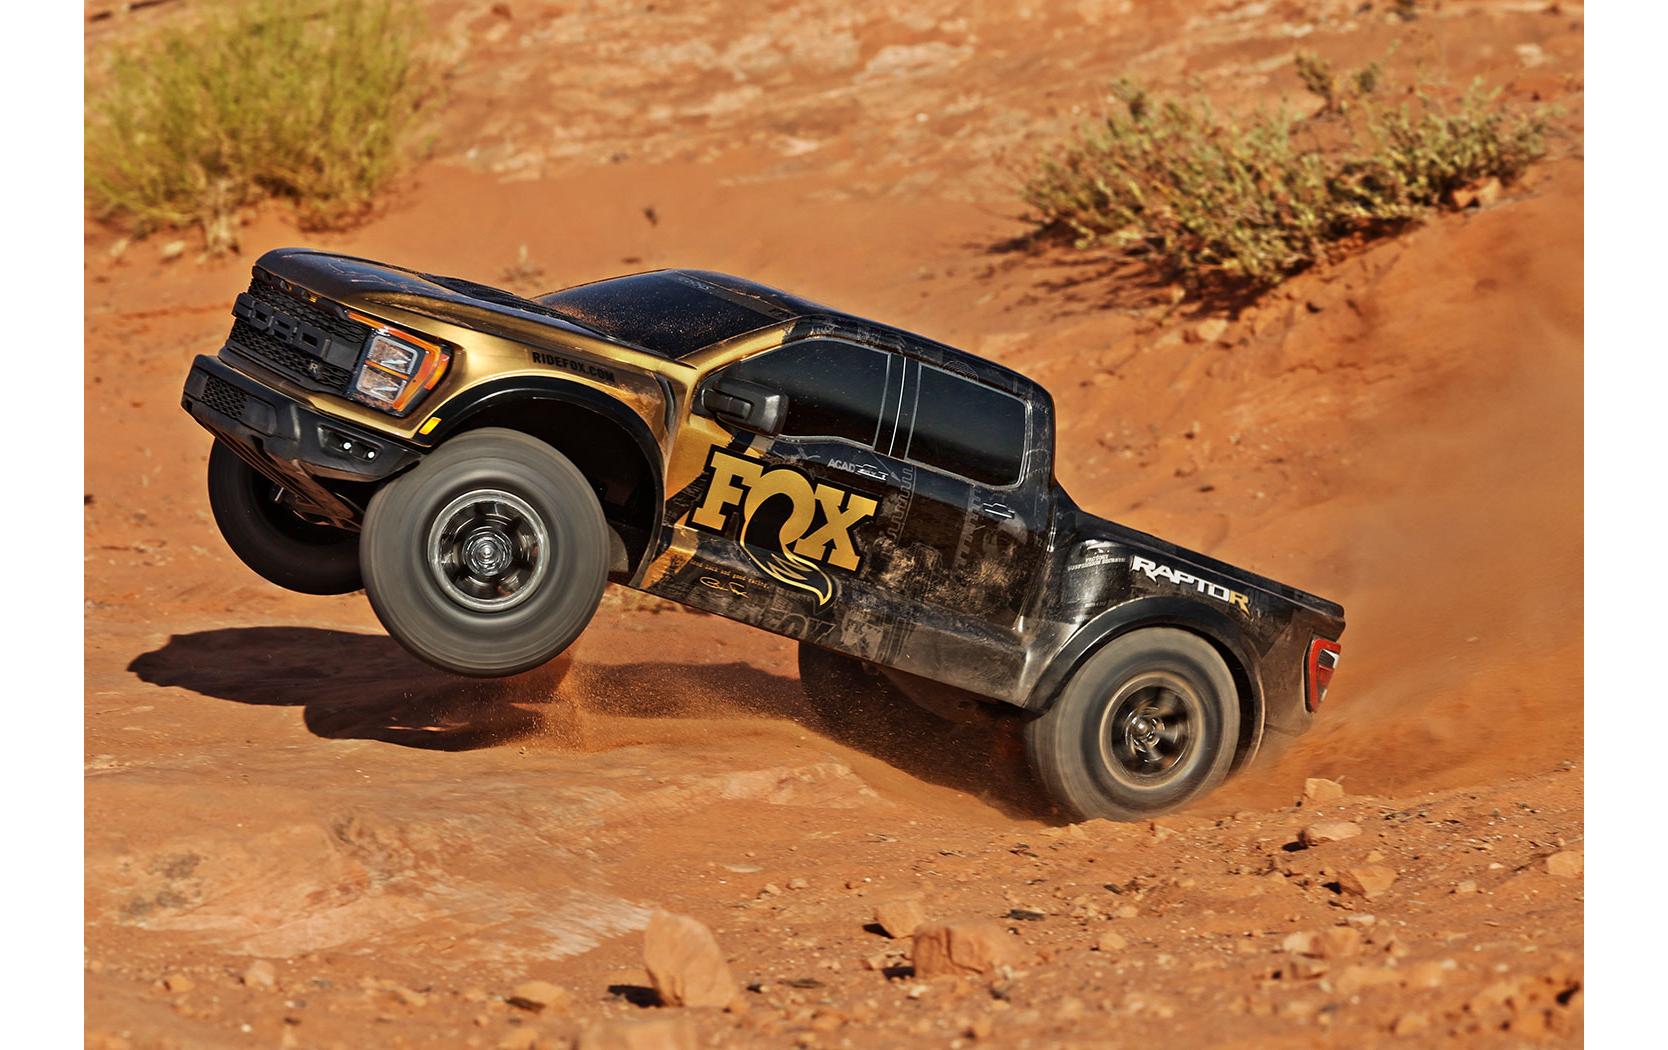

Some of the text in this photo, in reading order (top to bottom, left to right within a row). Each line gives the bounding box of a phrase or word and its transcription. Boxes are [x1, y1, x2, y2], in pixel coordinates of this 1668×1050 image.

[532, 351, 616, 383] RIDEFOX.COM
[826, 458, 860, 476] ACAD
[691, 450, 879, 606] FOX
[1131, 555, 1251, 619] RAPTOR
